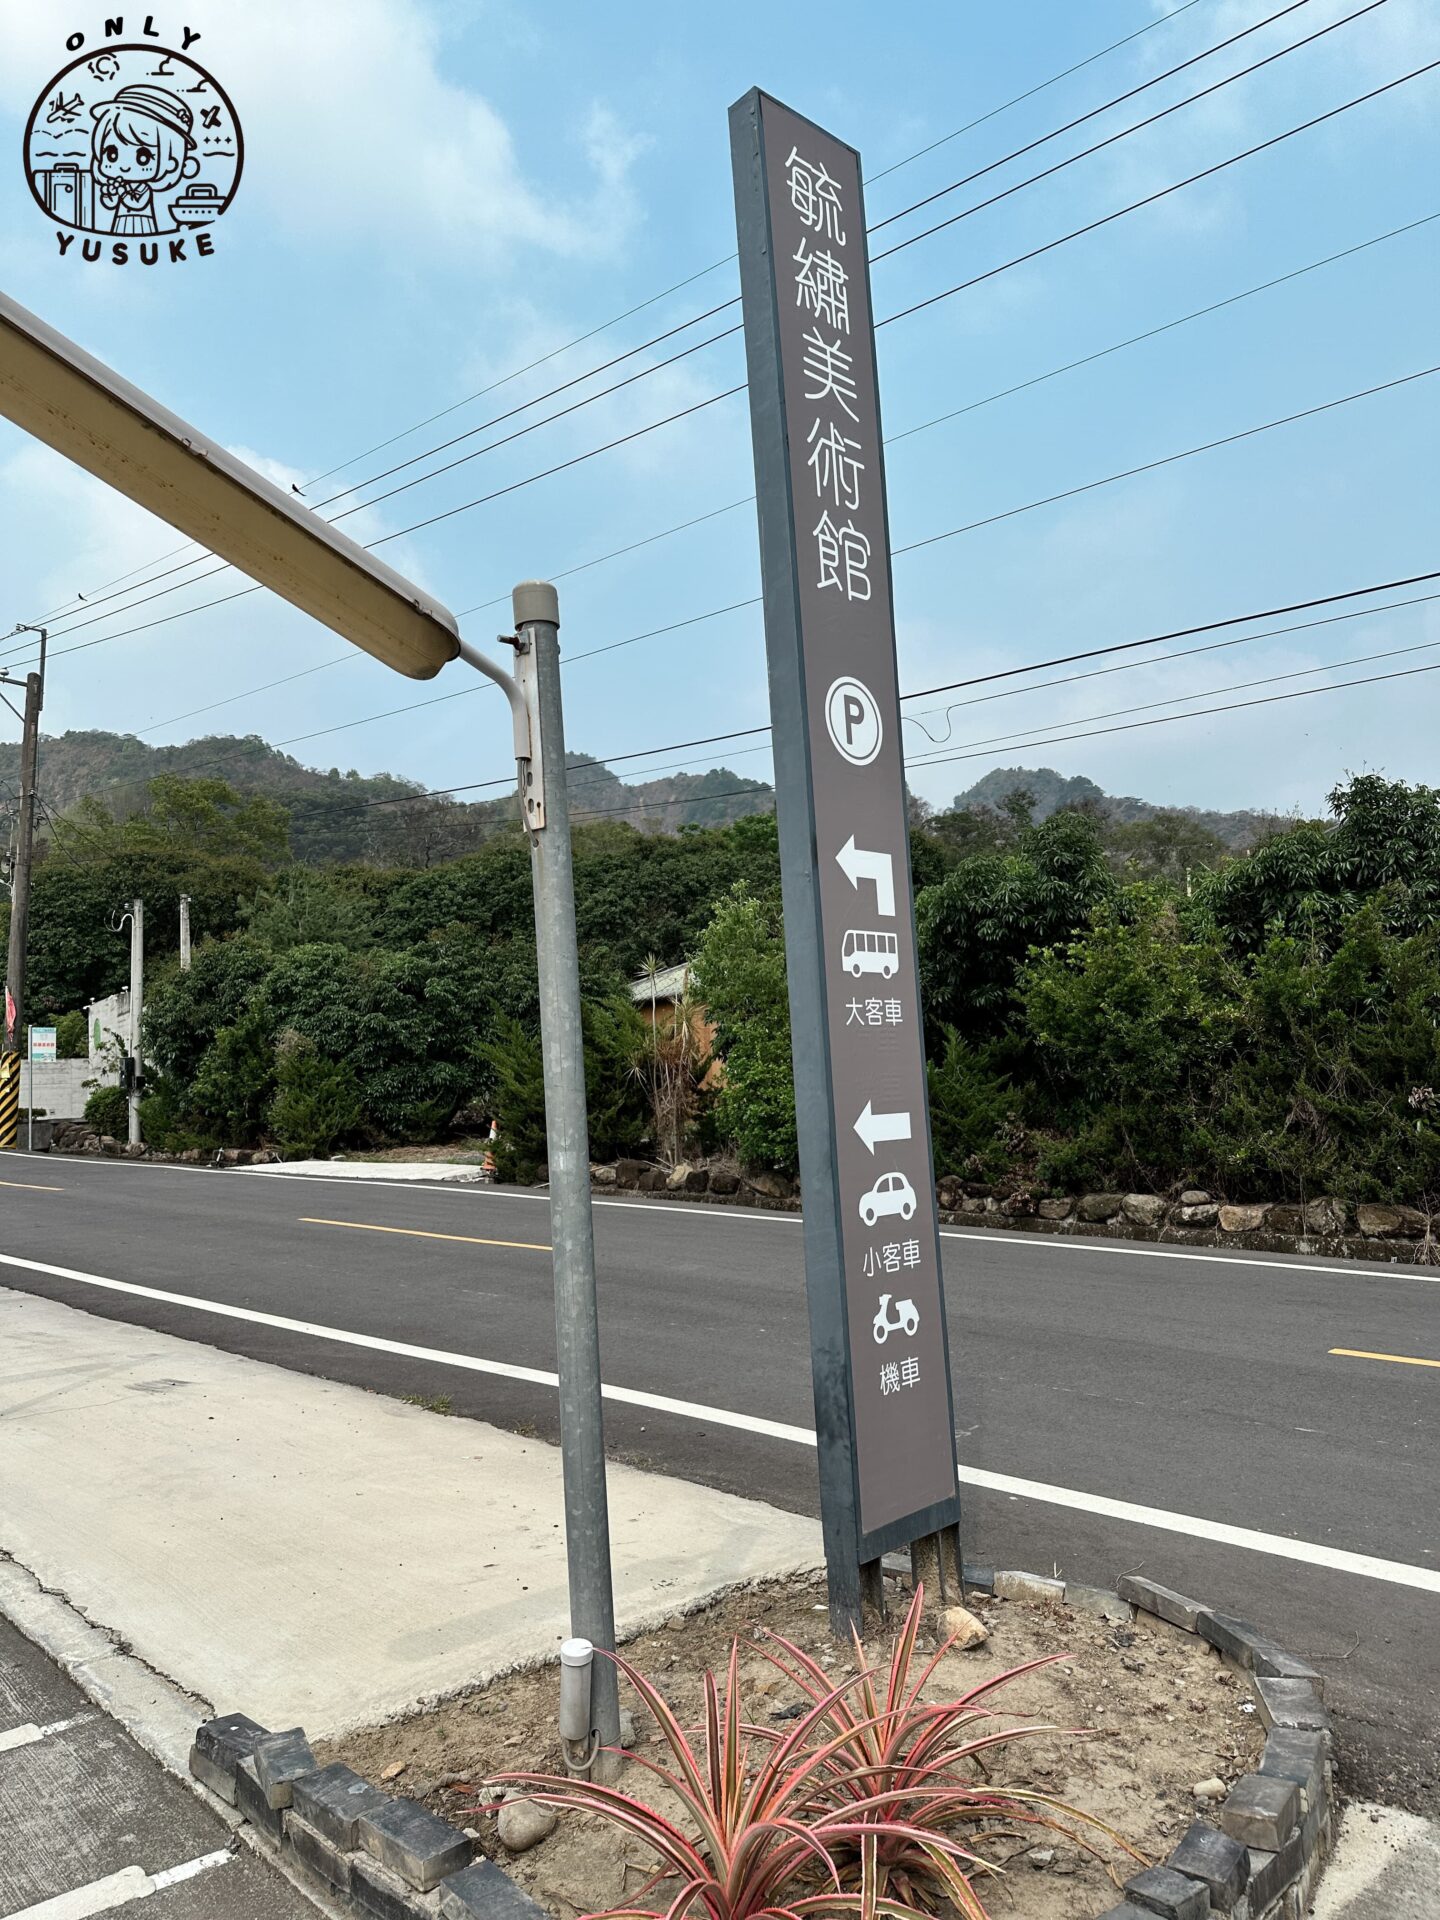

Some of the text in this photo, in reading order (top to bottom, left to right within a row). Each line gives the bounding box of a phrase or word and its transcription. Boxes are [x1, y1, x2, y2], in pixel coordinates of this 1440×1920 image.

[784, 146, 871, 600] 毓繡美術館
[843, 694, 865, 745] P
[845, 997, 903, 1026] 大客車
[862, 1238, 921, 1277] 小客車
[879, 1356, 921, 1395] 機車
